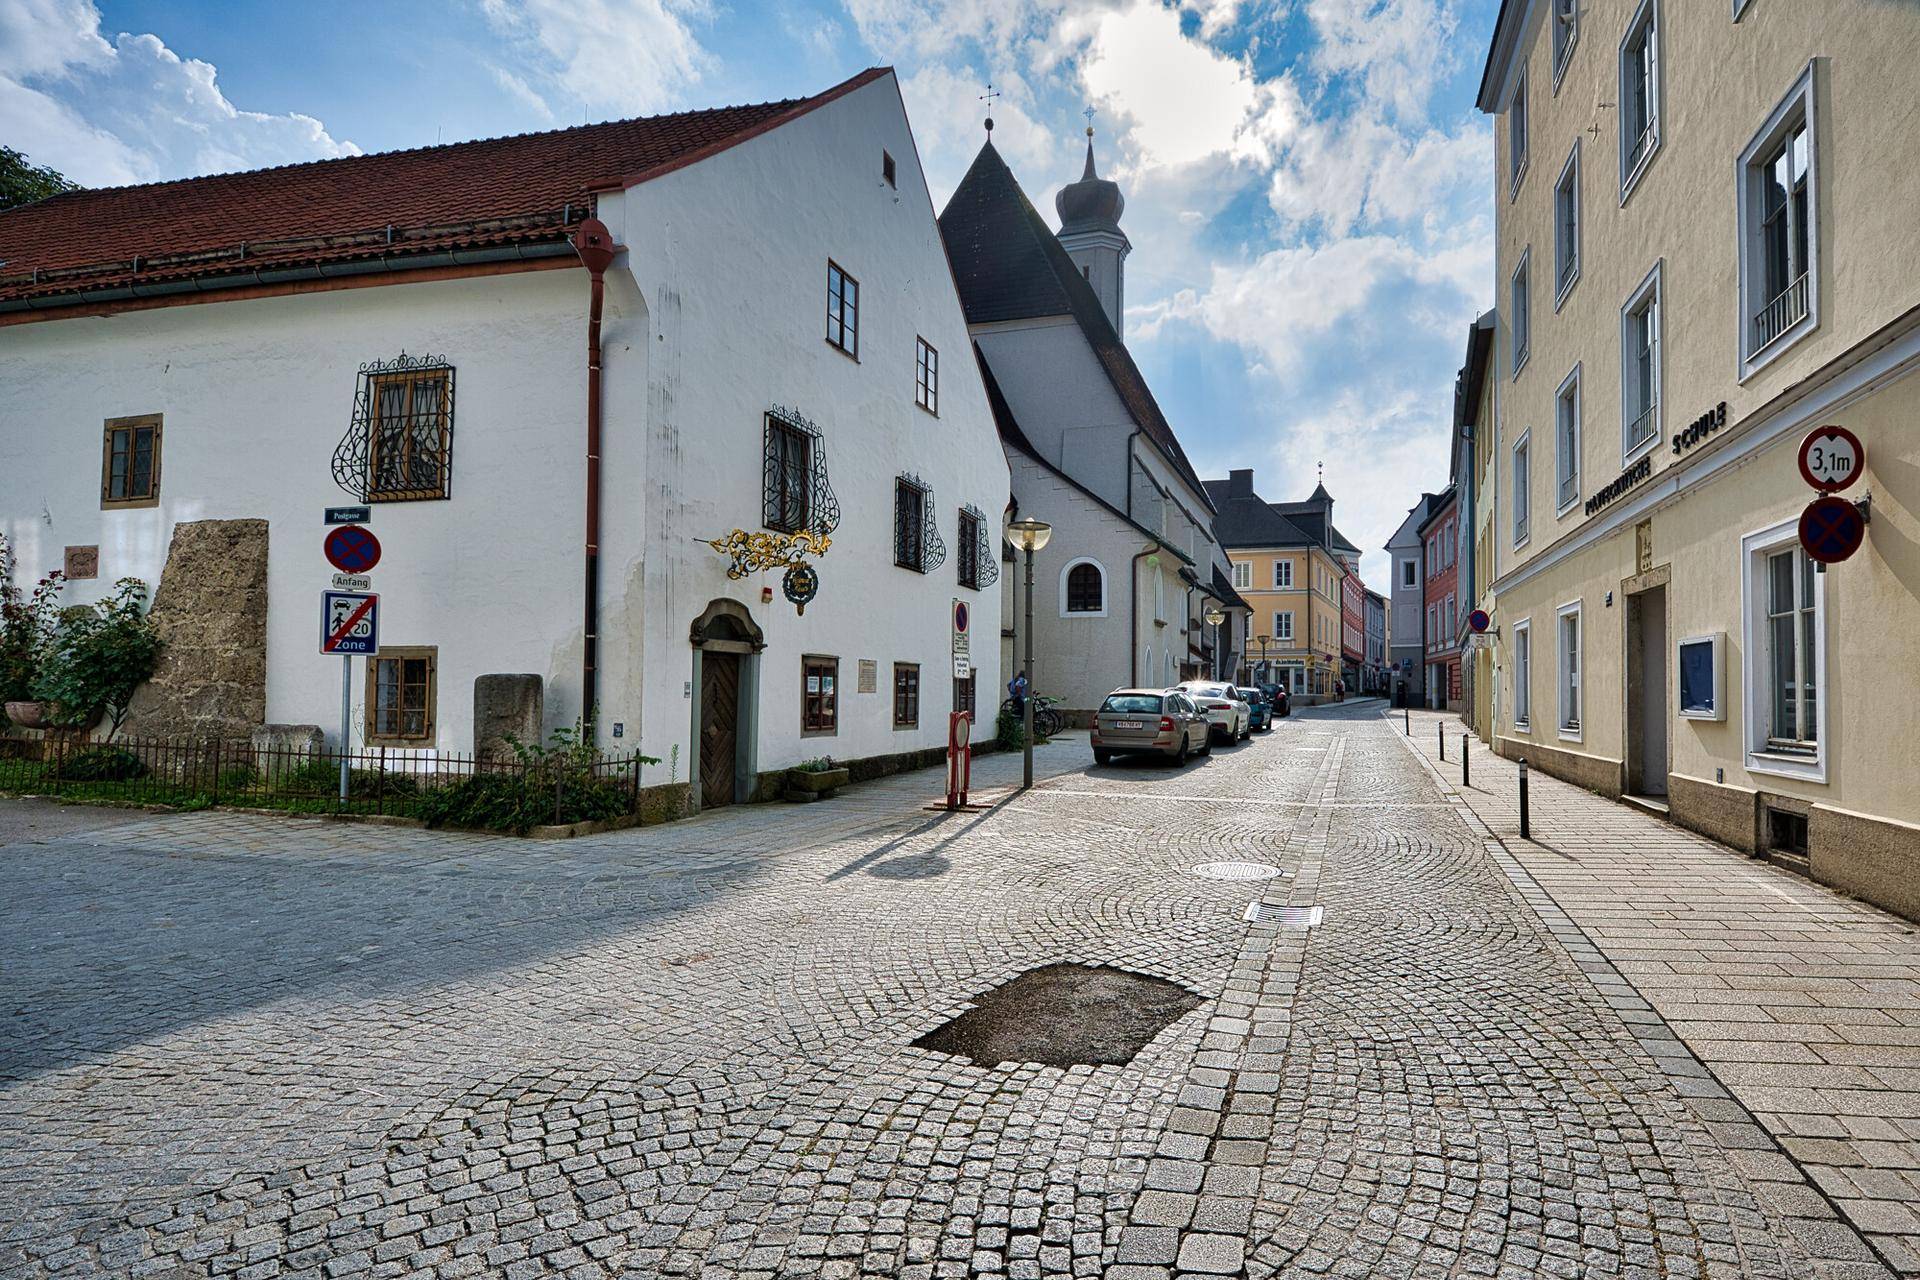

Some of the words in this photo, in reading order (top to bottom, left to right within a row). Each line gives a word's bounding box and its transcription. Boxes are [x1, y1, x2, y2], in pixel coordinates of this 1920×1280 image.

[1672, 401, 1727, 454] SCHULE
[1812, 447, 1850, 474] 3,1m
[333, 512, 360, 521] Postgasse
[336, 577, 369, 588] Anfang
[353, 623, 369, 635] 20
[335, 640, 366, 650] Zone
